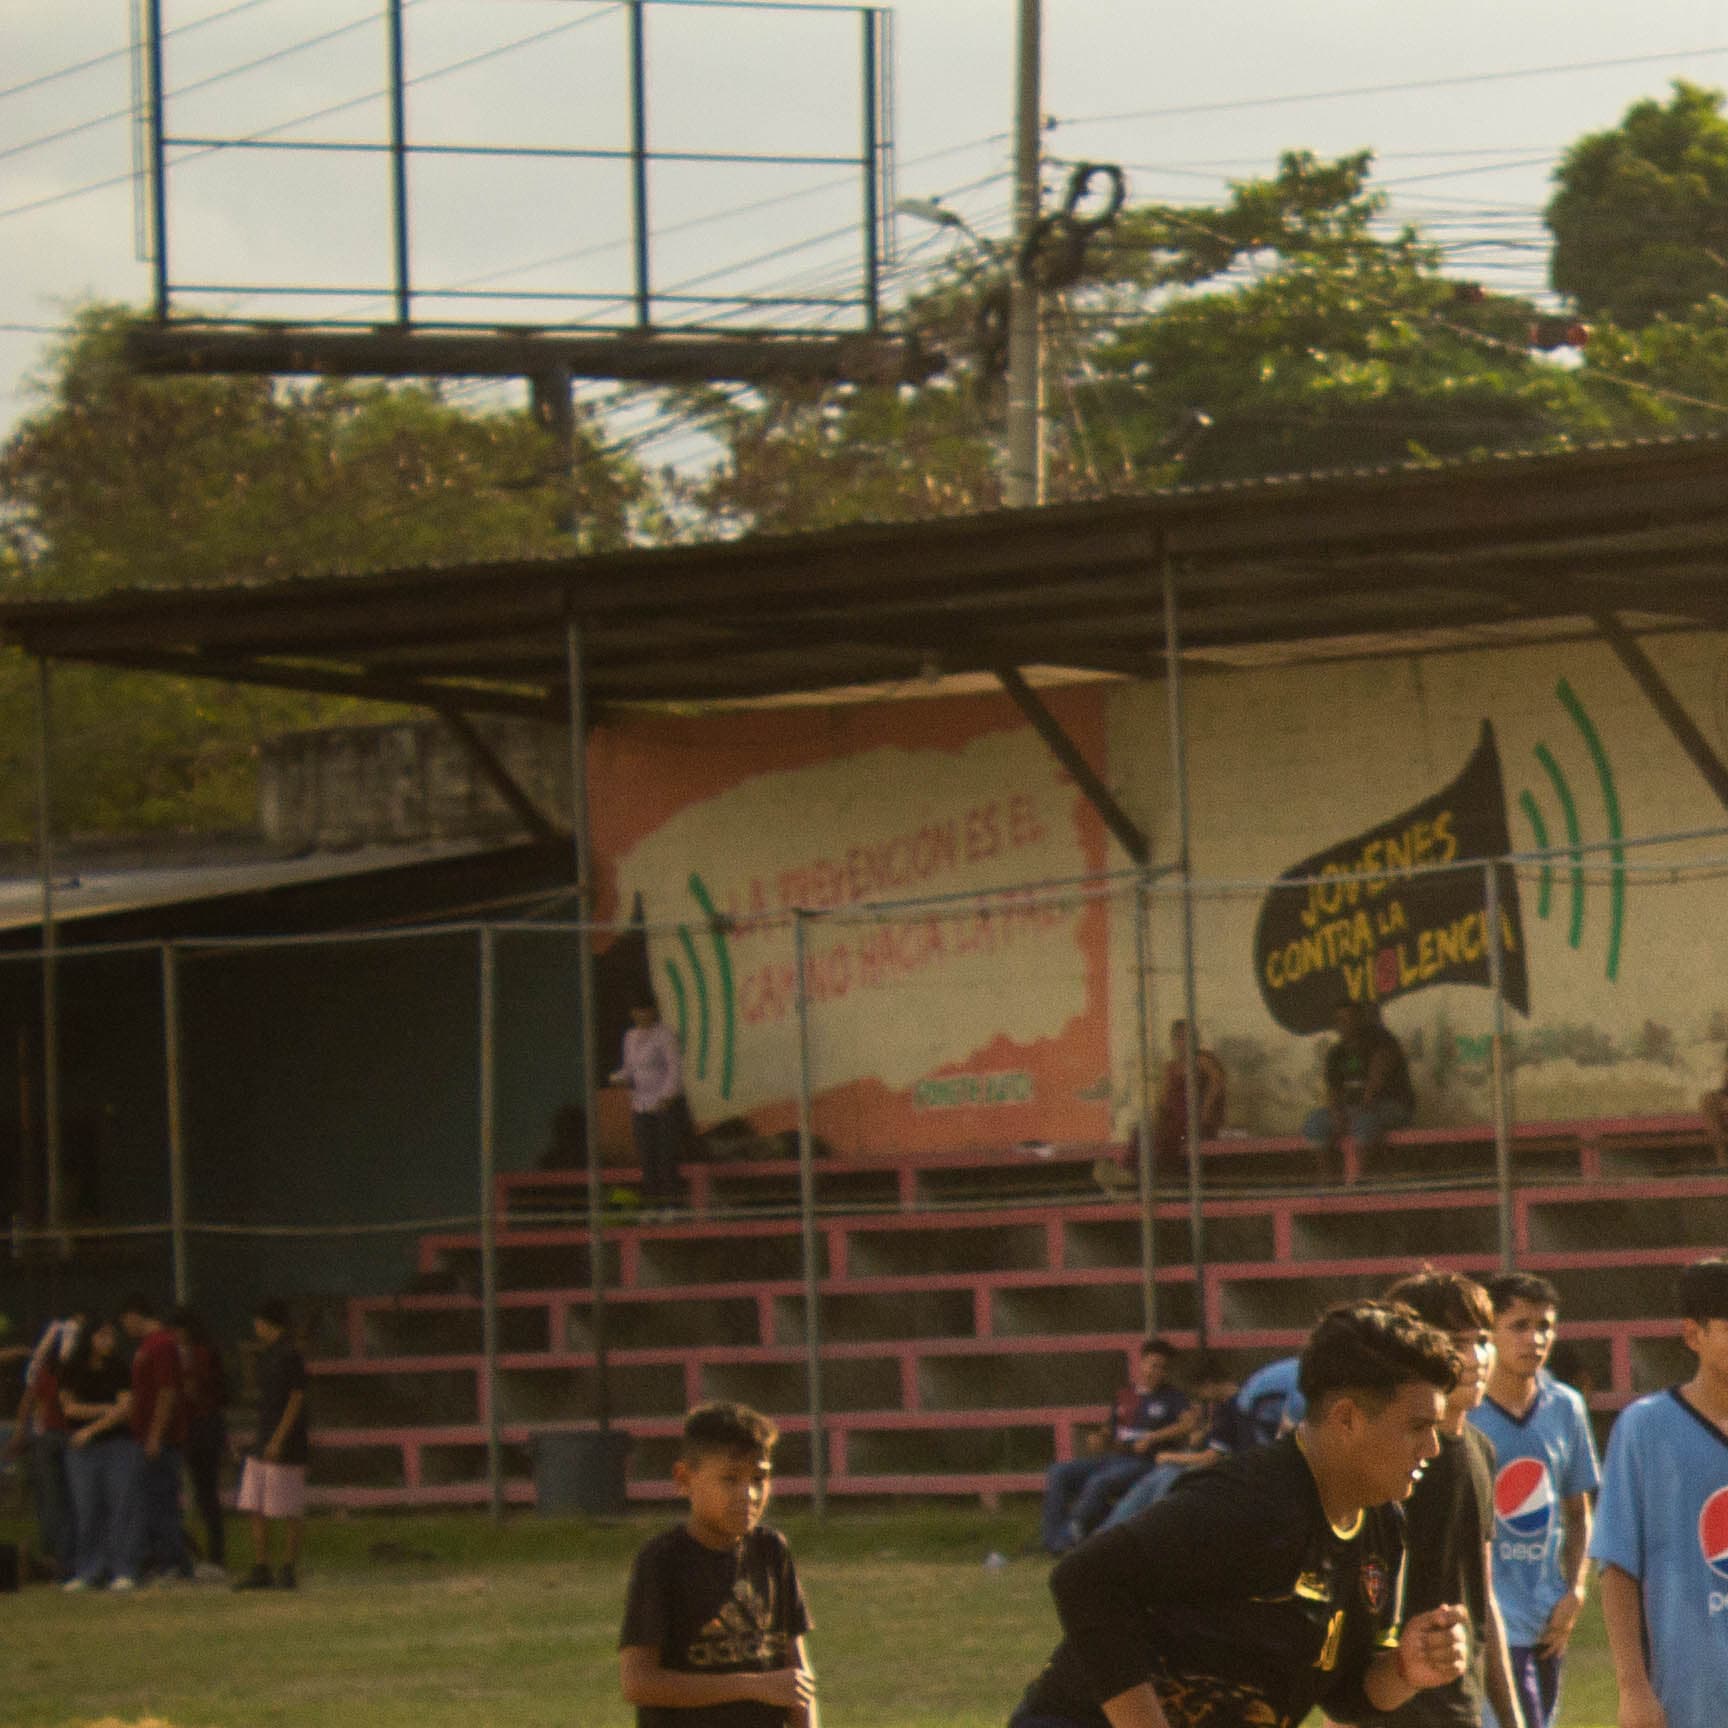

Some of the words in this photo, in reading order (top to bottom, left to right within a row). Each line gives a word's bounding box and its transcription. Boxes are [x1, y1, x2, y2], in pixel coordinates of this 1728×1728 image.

[1301, 811, 1456, 928] JOVENES
[1266, 912, 1374, 989] CONTRA
[1376, 900, 1409, 936] LA
[1343, 906, 1514, 1001] VIOLENCIA
